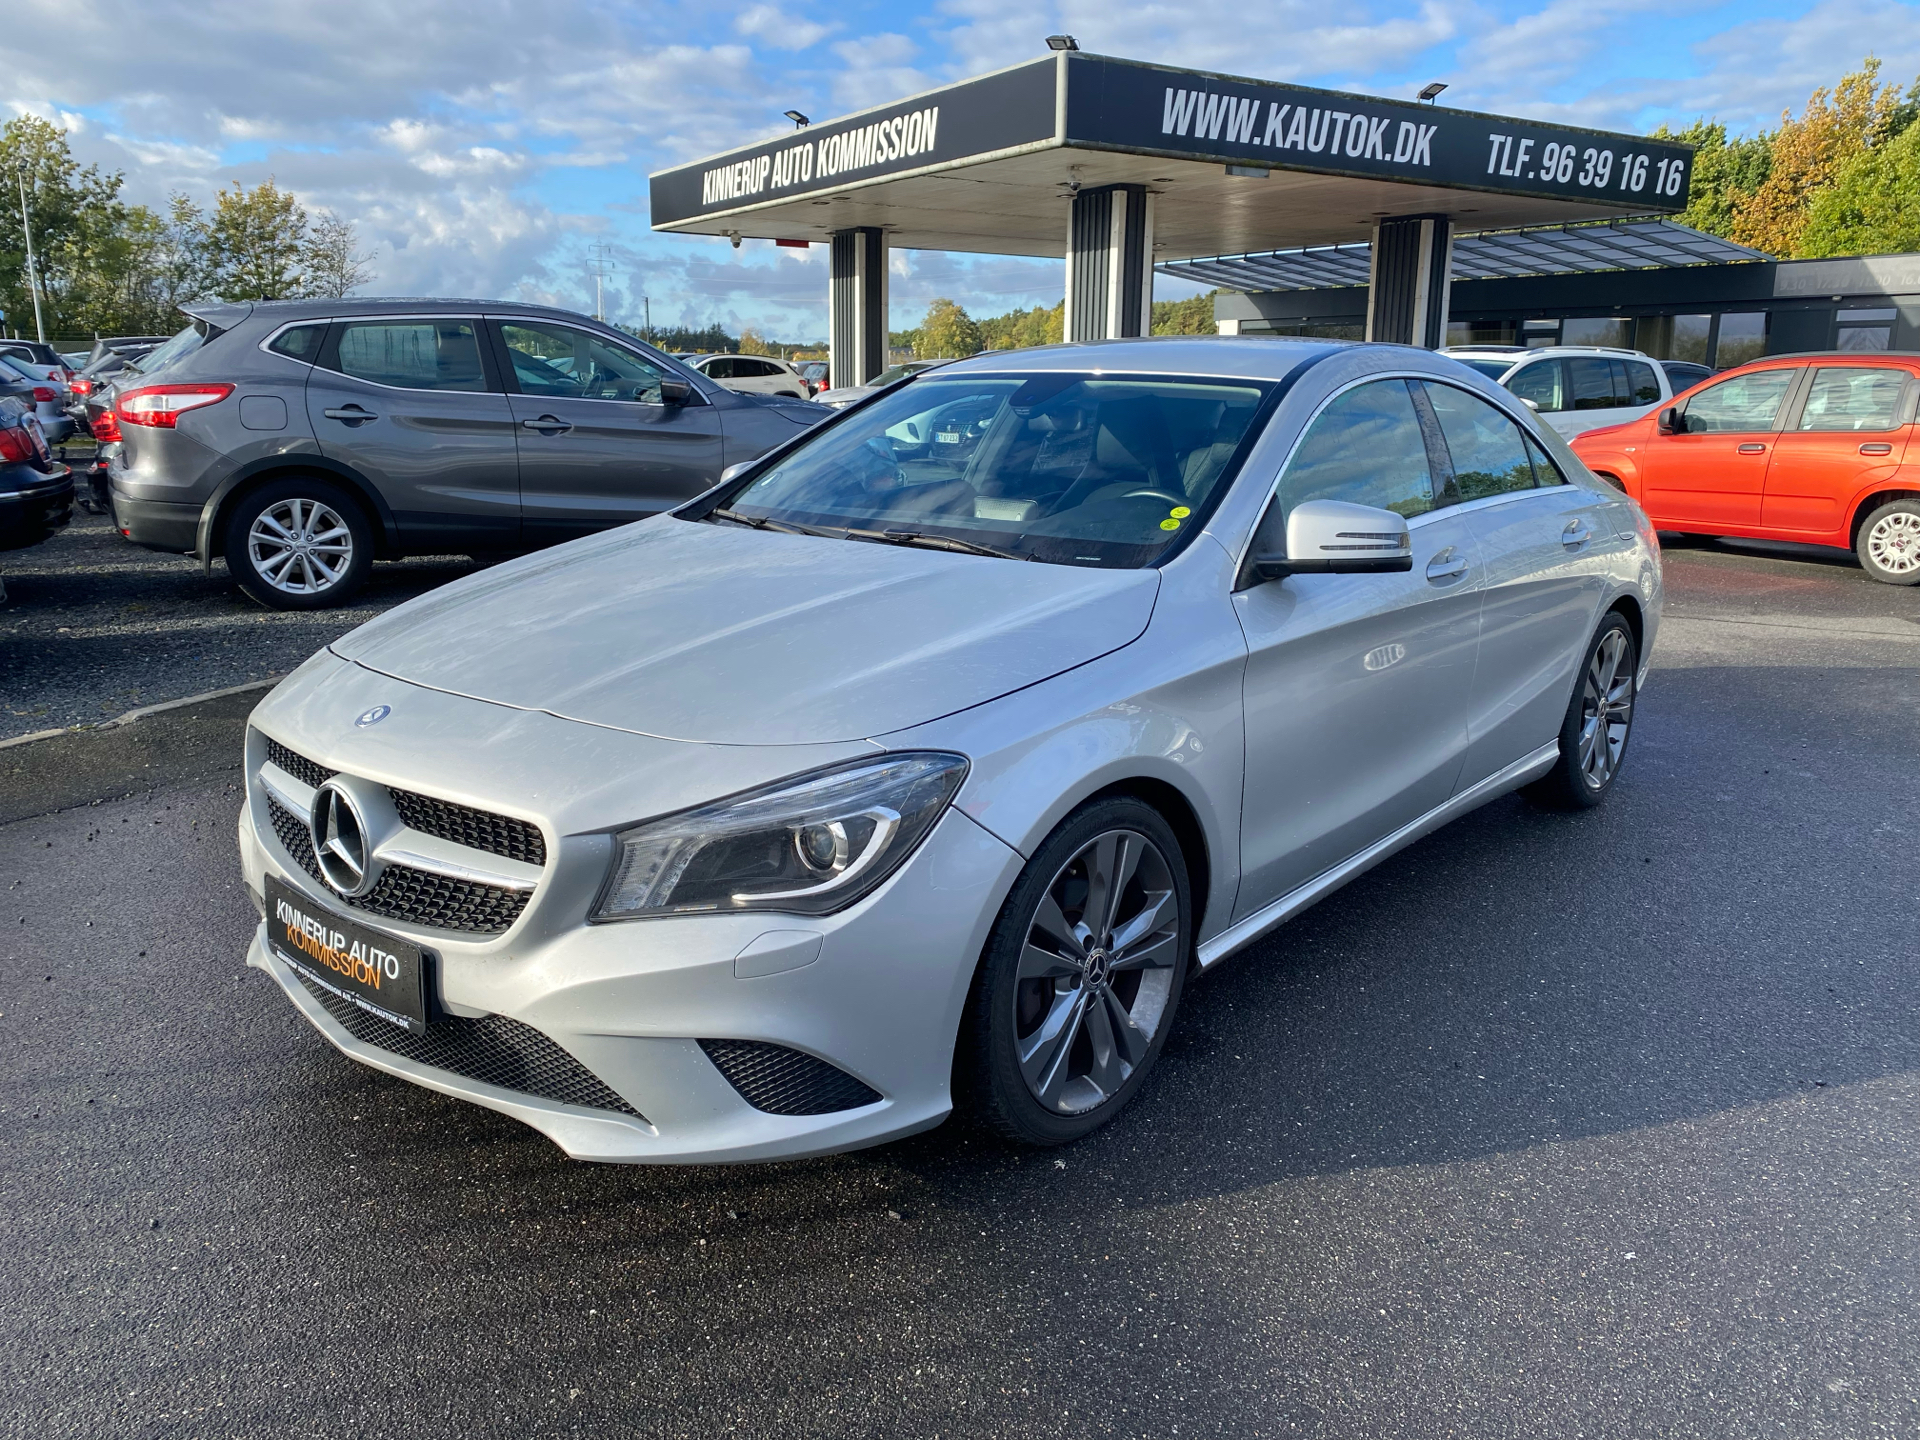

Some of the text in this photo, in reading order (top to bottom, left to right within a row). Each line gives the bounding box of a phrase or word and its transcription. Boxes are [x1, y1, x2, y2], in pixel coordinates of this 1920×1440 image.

[703, 106, 939, 205] KINNERUP AUTO KOMMISSION
[1161, 87, 1438, 167] WWW.KAUTOK.DK
[1487, 133, 1685, 196] TLF. 96 39 16 16
[276, 898, 399, 980] KINNERUP AUTO
[287, 922, 381, 990] KOMMISSION
